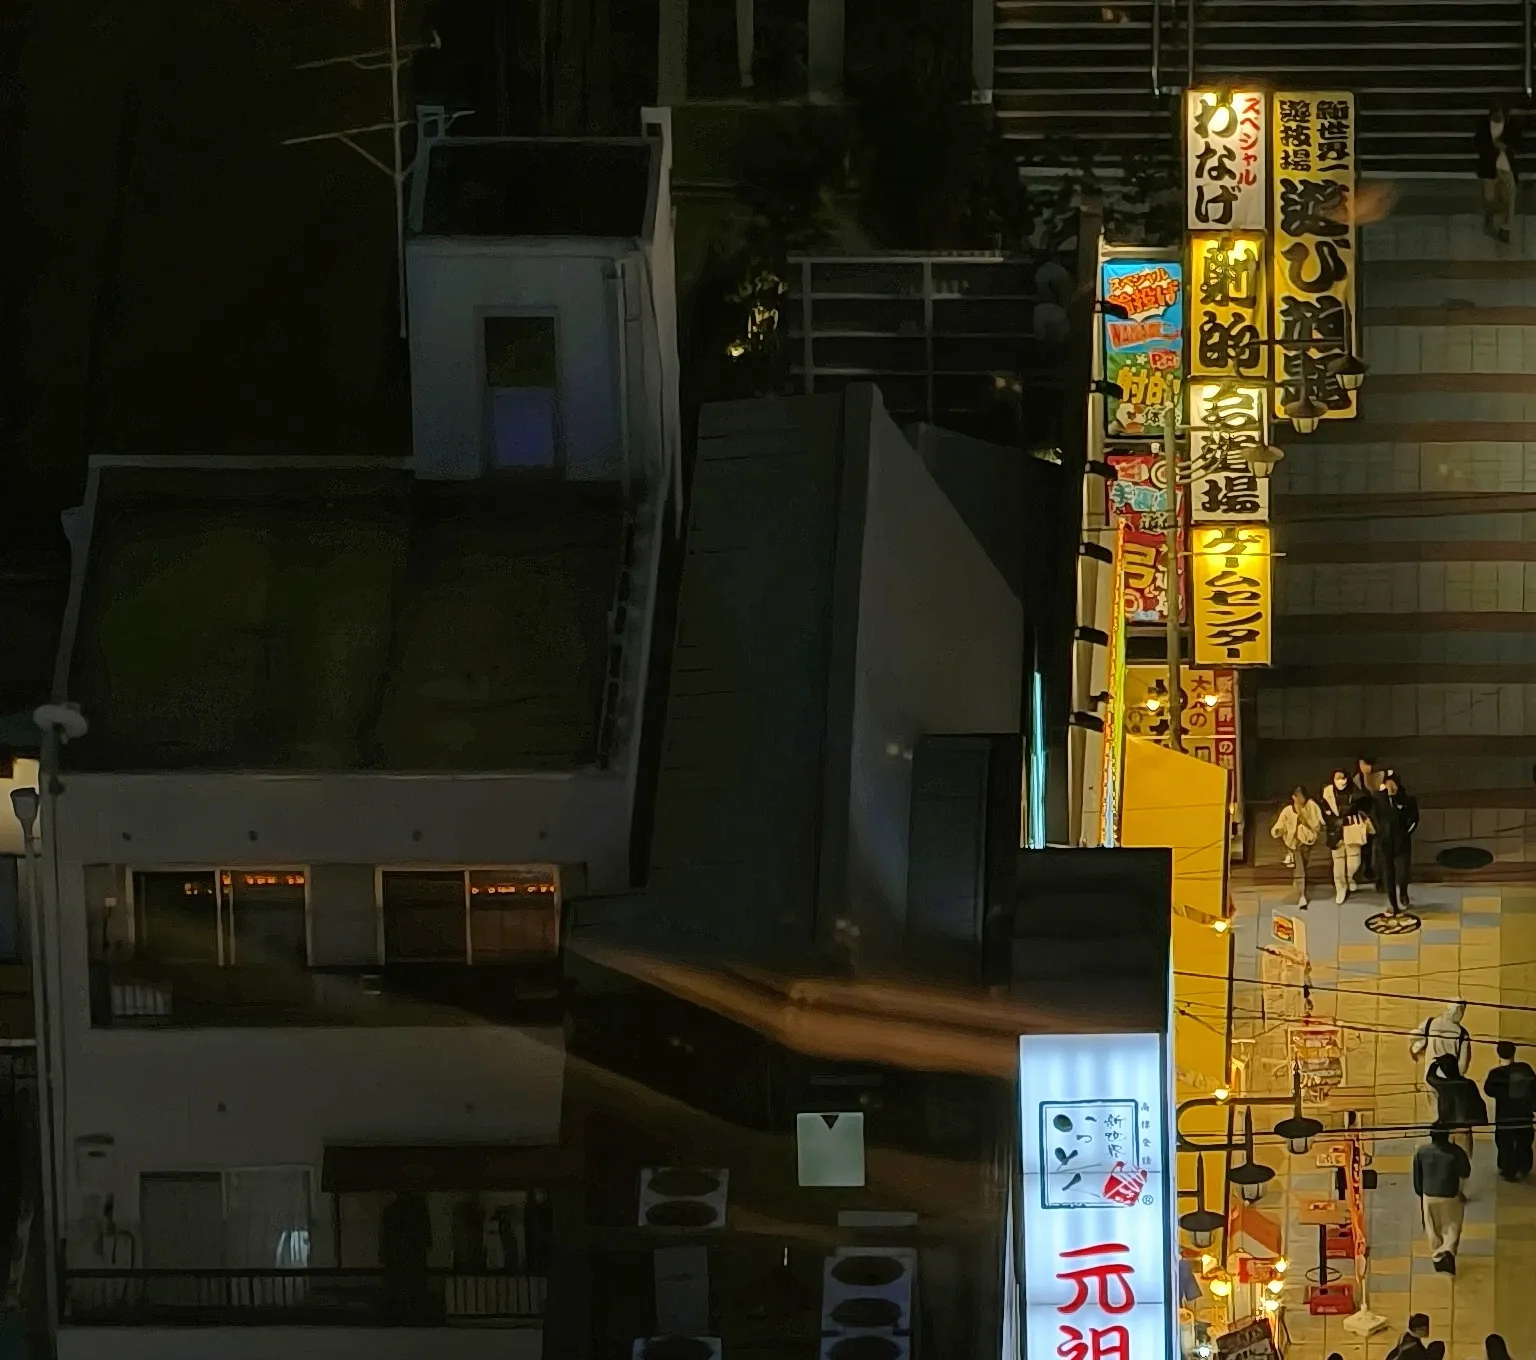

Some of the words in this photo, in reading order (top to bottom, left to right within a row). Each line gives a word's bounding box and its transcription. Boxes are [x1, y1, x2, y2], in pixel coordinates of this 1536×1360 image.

[1194, 97, 1240, 226] わなげ
[1241, 97, 1256, 187] スペシャル
[1199, 243, 1259, 372] 射的
[1200, 530, 1264, 659] ゲームセンター
